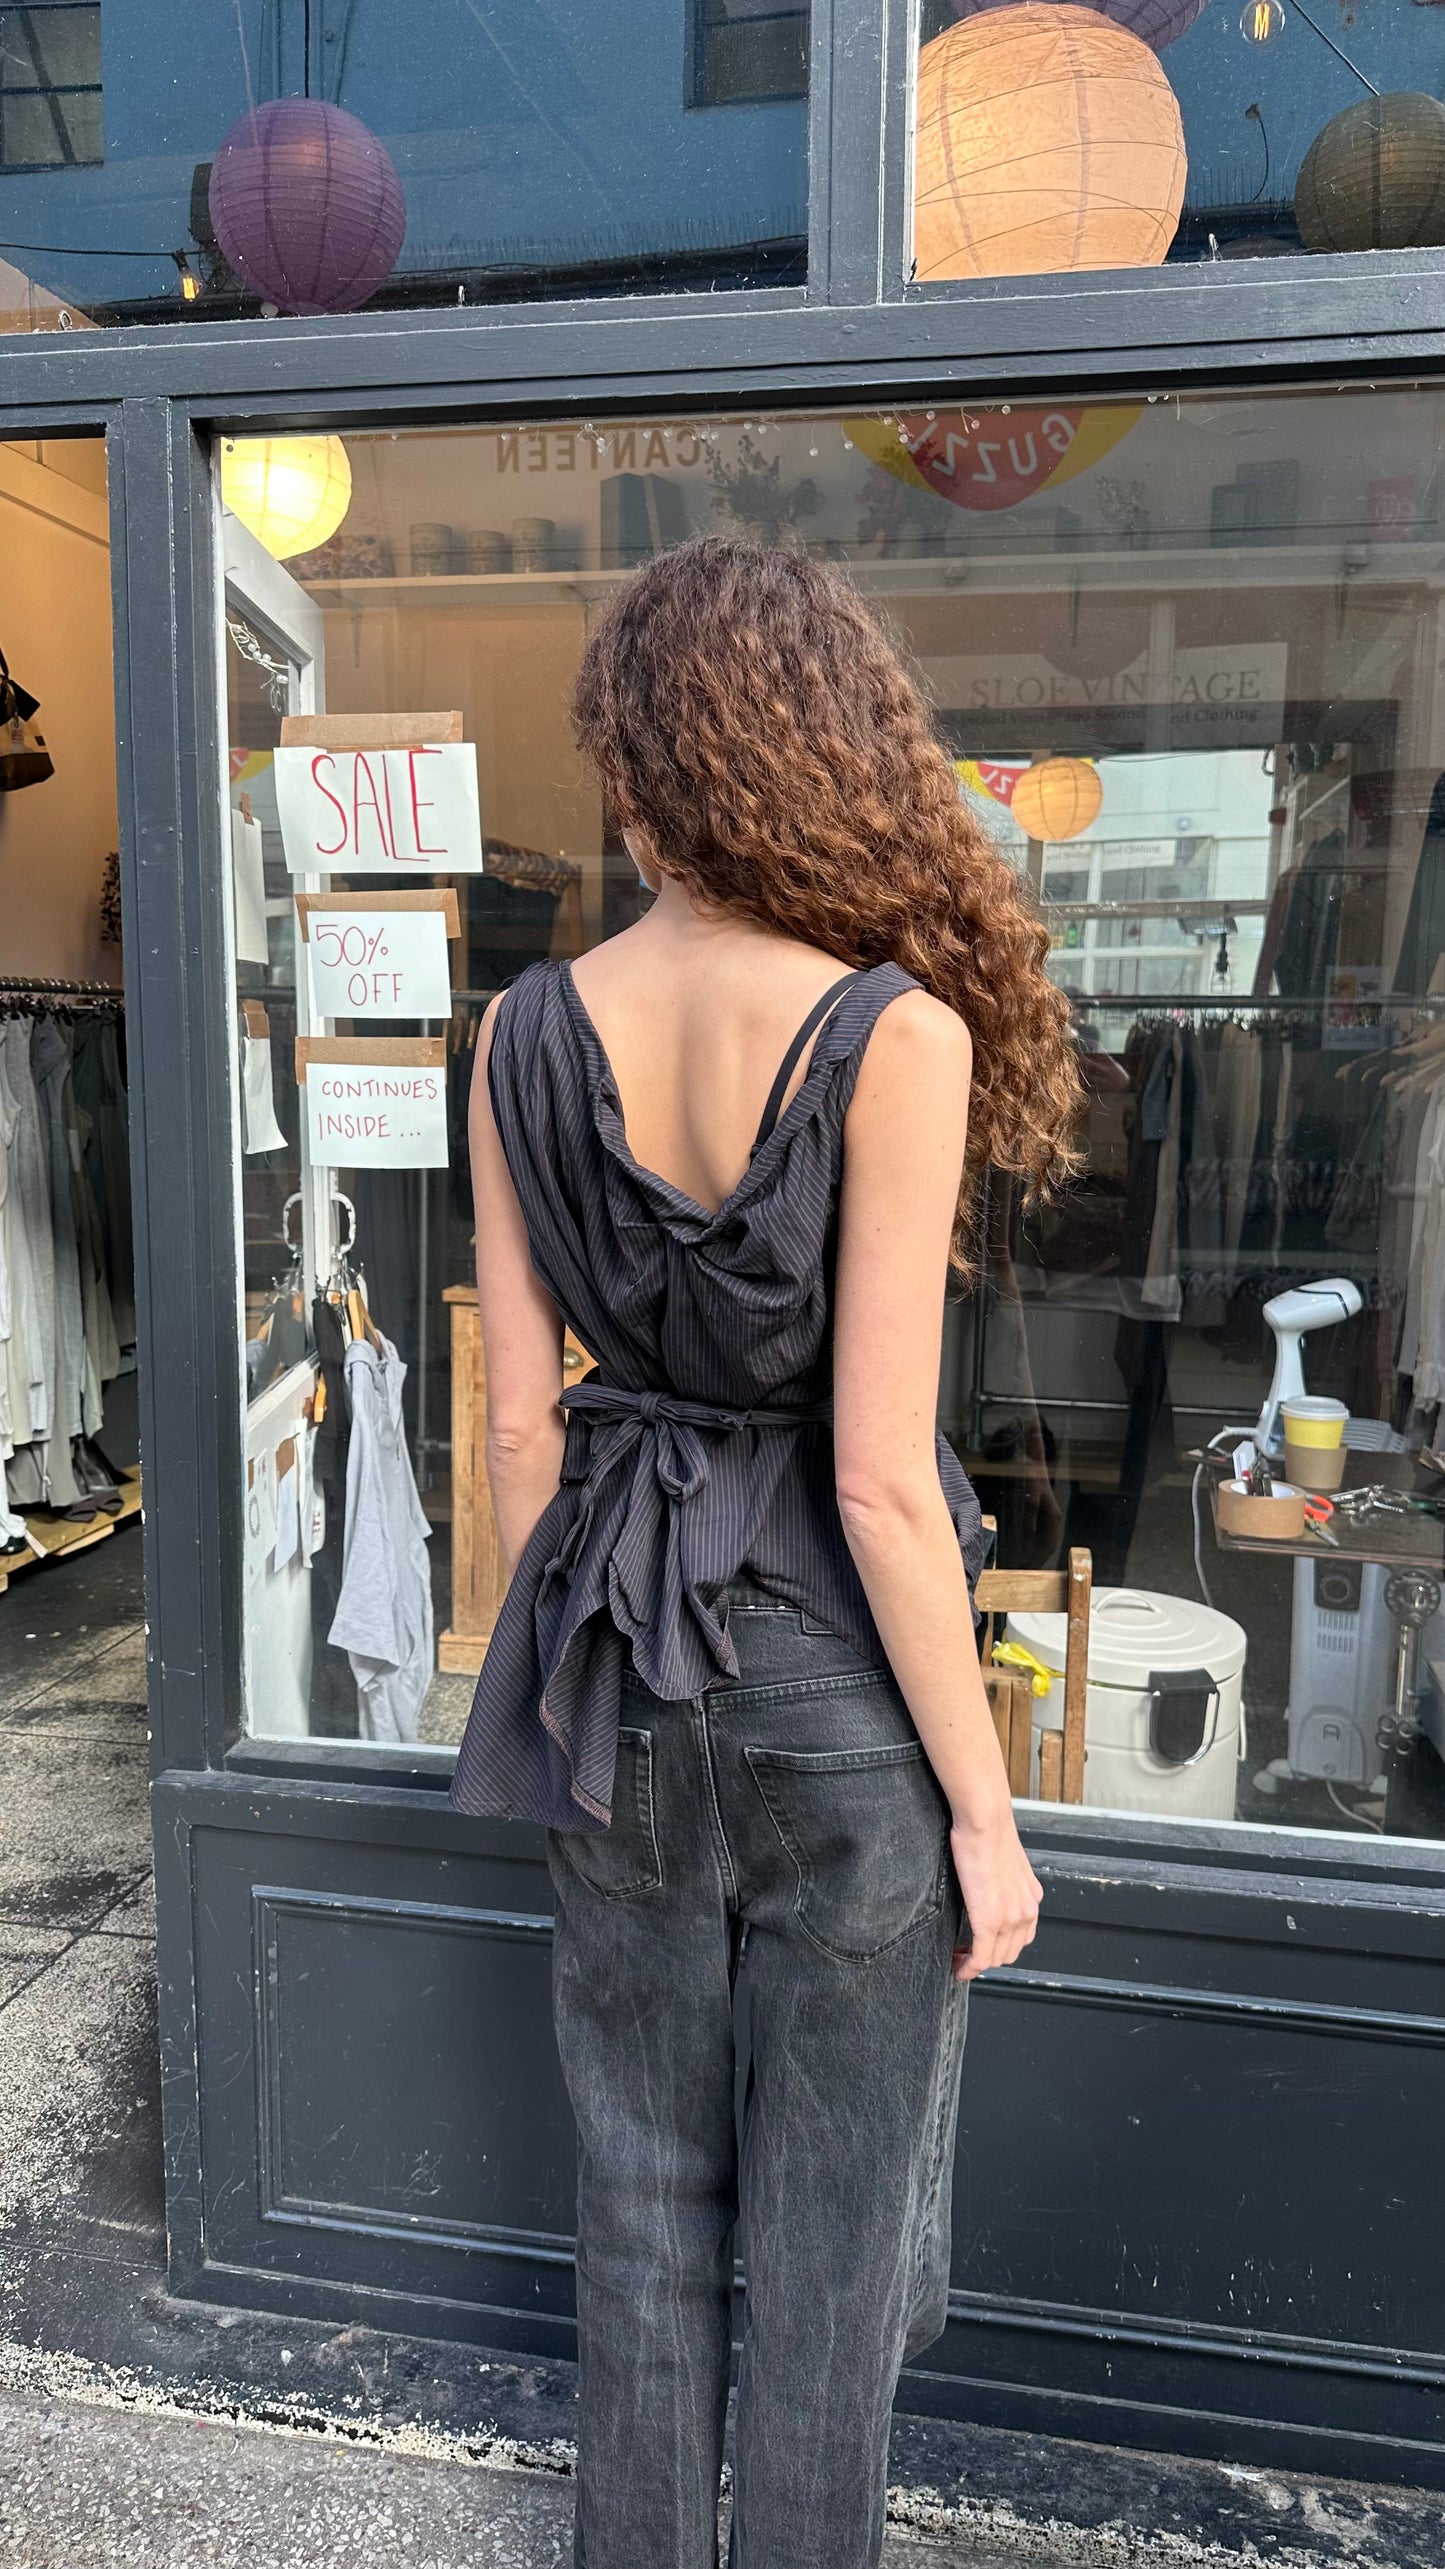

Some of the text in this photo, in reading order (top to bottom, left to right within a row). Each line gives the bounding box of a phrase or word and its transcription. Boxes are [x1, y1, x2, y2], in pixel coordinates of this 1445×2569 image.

[970, 670, 1260, 706] SLOE VINAGE
[311, 748, 448, 862] SALE
[315, 923, 389, 968] 50%
[347, 972, 404, 1007] OFF
[321, 1078, 438, 1100] CONTINUES
